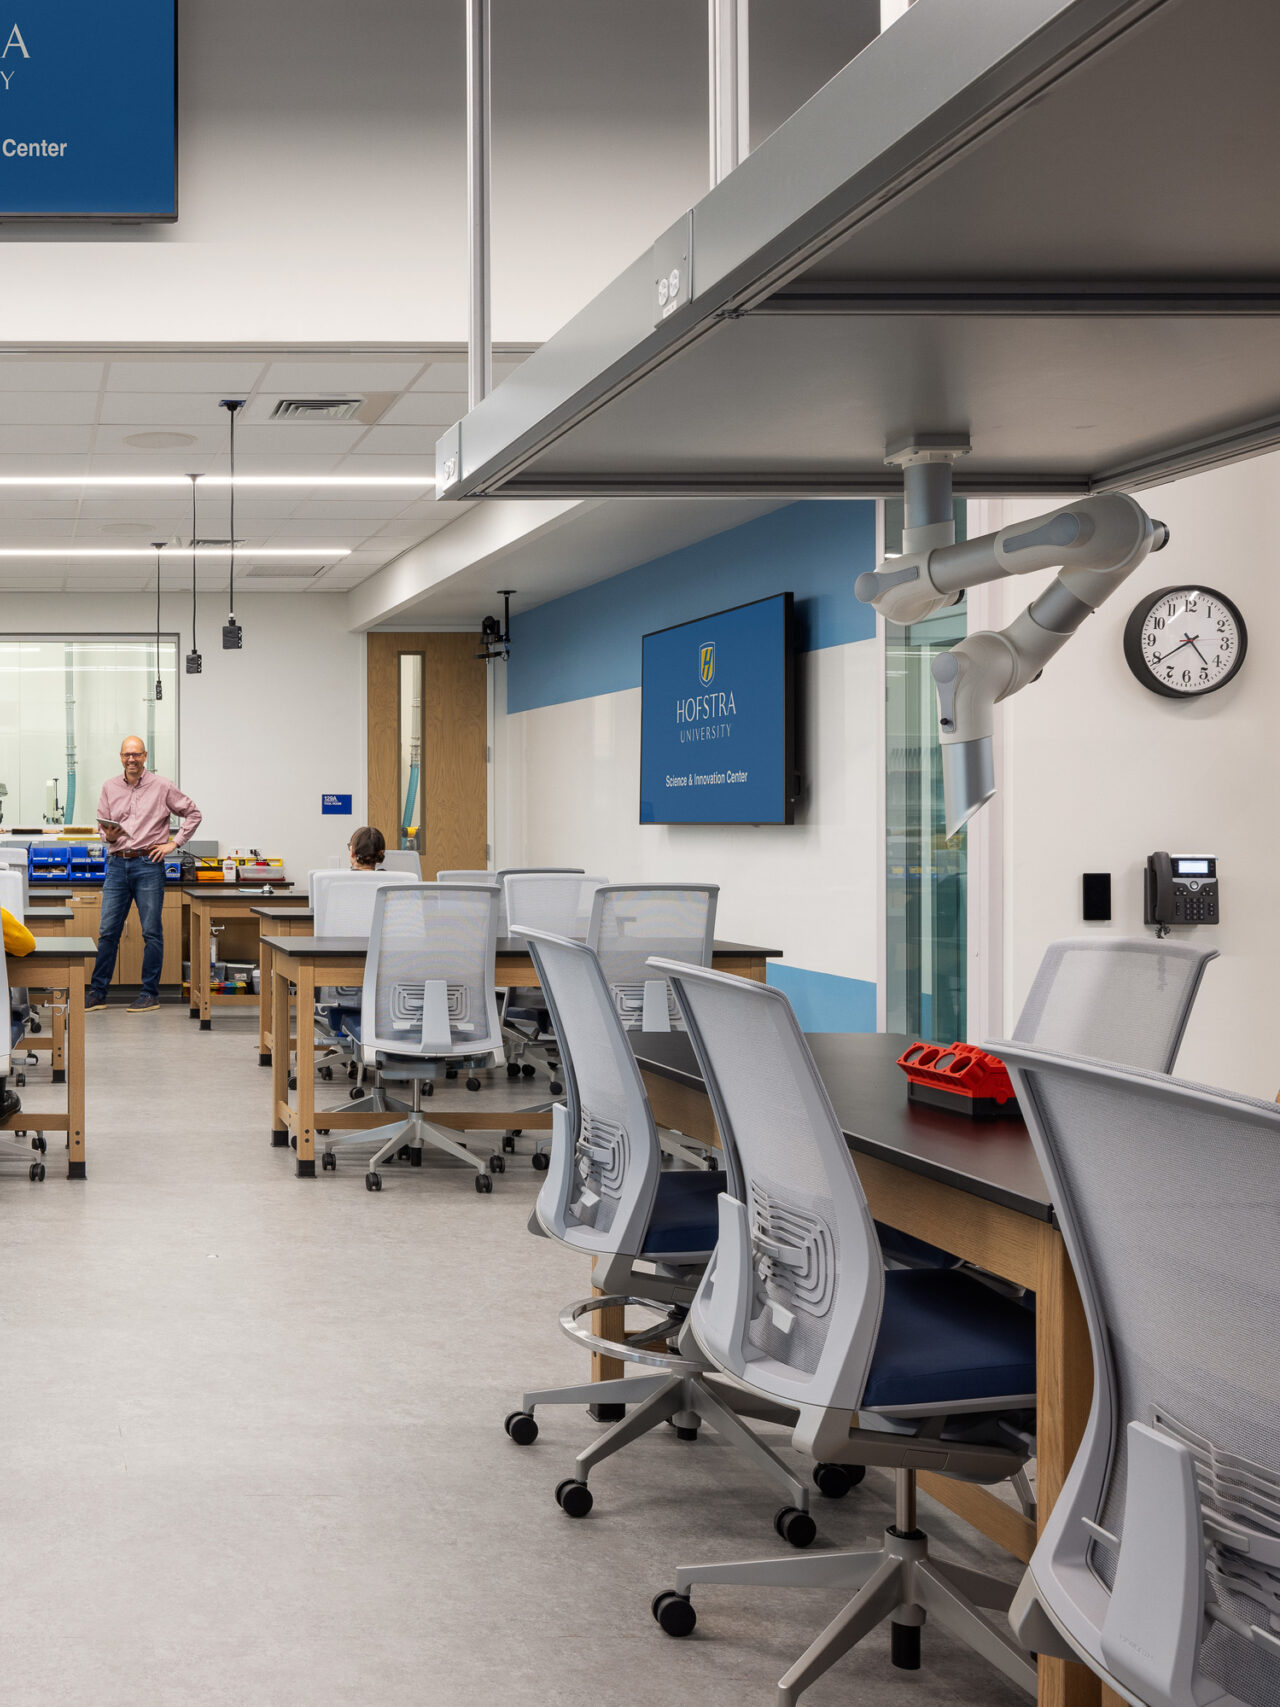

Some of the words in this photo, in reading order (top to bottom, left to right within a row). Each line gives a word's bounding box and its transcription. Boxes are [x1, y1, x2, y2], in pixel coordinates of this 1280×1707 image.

[2, 138, 68, 158] Center
[1184, 600, 1197, 613] 12
[1207, 606, 1211, 618] 1
[1153, 617, 1166, 630] 10
[1217, 620, 1225, 632] 2
[1147, 633, 1156, 646] 9
[1220, 637, 1230, 651] 3
[1151, 651, 1162, 665] 8
[1212, 655, 1222, 667] 4
[1167, 666, 1174, 679] 7
[1182, 670, 1191, 683] 6
[1199, 667, 1209, 680] 5
[676, 690, 737, 724] HOFSTRA
[680, 723, 732, 744] UNIVERSITY
[665, 775, 688, 788] Science
[688, 774, 694, 786] &
[693, 771, 726, 786] Innovation
[726, 769, 748, 784] Center
